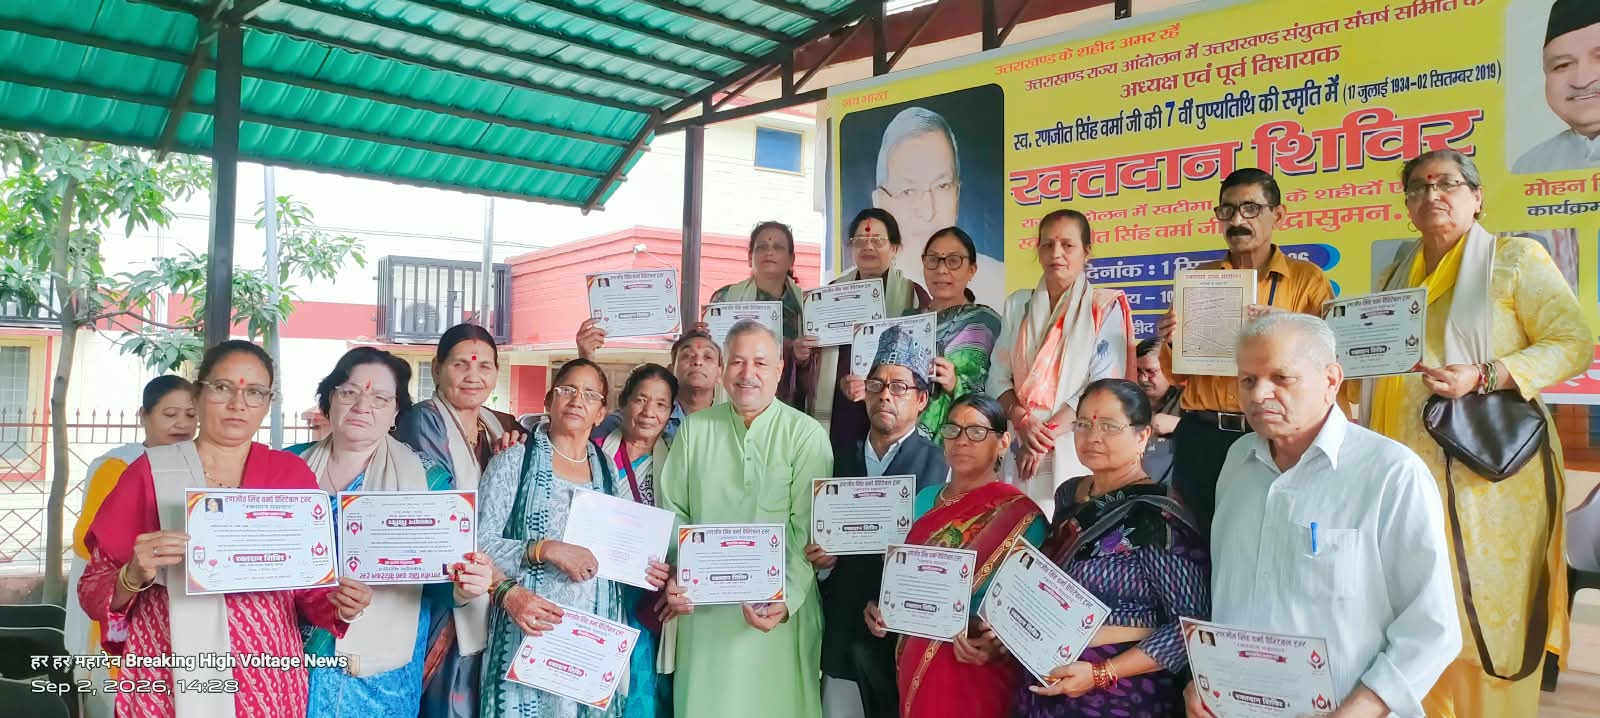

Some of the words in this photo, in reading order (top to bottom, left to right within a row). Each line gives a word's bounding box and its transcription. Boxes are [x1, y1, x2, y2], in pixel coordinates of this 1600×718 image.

[994, 53, 1056, 75] उत्तराखण्ड
[1058, 48, 1073, 61] के
[1077, 40, 1117, 57] शहीद
[1119, 32, 1156, 48] अमर
[1159, 23, 1181, 41] रहें
[1024, 71, 1085, 92] उत्तराखण्ड
[1086, 63, 1118, 79] राज्य
[1121, 50, 1181, 72] आंदोलन
[1184, 43, 1200, 60] में
[1202, 31, 1281, 57] उत्तराखण्ड
[1281, 22, 1339, 43] संयुक्त
[1343, 6, 1390, 29] संघर्ष
[1120, 73, 1179, 98] अध्यक्ष
[1183, 62, 1212, 88] एवं
[1216, 56, 1248, 85] पूर्व
[1251, 45, 1343, 75] विधायक
[1013, 133, 1032, 151] स्व.
[1035, 121, 1073, 148] रणजीत
[1076, 115, 1099, 142] सिंह
[1100, 110, 1123, 137] वर्मा
[1126, 108, 1142, 133] जी
[1144, 104, 1162, 131] की
[1165, 101, 1175, 127] 7
[1178, 98, 1194, 126] वीं
[1196, 89, 1255, 130] पुण्यतिथि
[1258, 85, 1279, 112] की
[1282, 79, 1322, 115] स्मृति
[1324, 74, 1340, 103] में
[1358, 77, 1388, 103] जुलाई
[1430, 69, 1474, 89] सितम्बर
[1009, 141, 1243, 206] रक्तदान
[1250, 107, 1485, 174] शिविर
[1132, 203, 1148, 217] में
[1152, 199, 1213, 216] खटीमा
[1286, 188, 1309, 202] के
[1314, 179, 1385, 200] शहीदों
[1524, 178, 1587, 197] मोहन
[1114, 224, 1152, 243] सिंह
[1154, 218, 1194, 239] वर्मा
